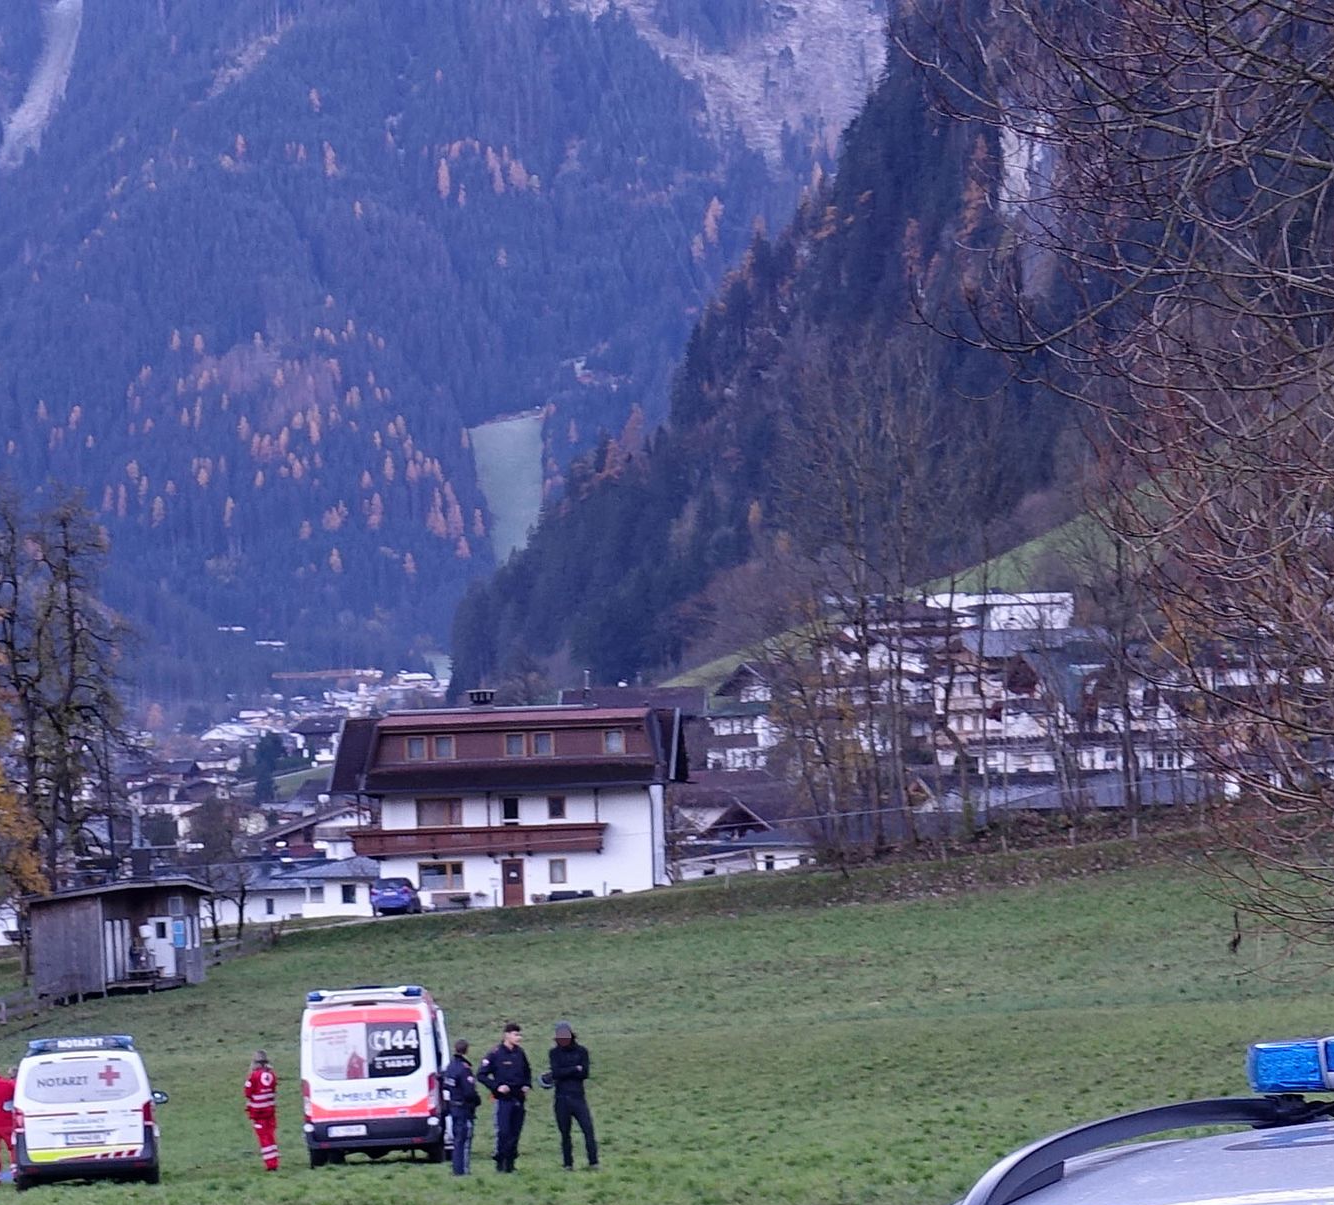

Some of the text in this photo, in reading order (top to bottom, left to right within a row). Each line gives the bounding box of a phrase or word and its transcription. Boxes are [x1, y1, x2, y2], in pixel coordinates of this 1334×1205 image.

[57, 1037, 104, 1048] NOTARZT
[380, 1028, 419, 1050] 144
[36, 1075, 89, 1089] NOTARZT
[333, 1088, 409, 1103] AMBULANCE
